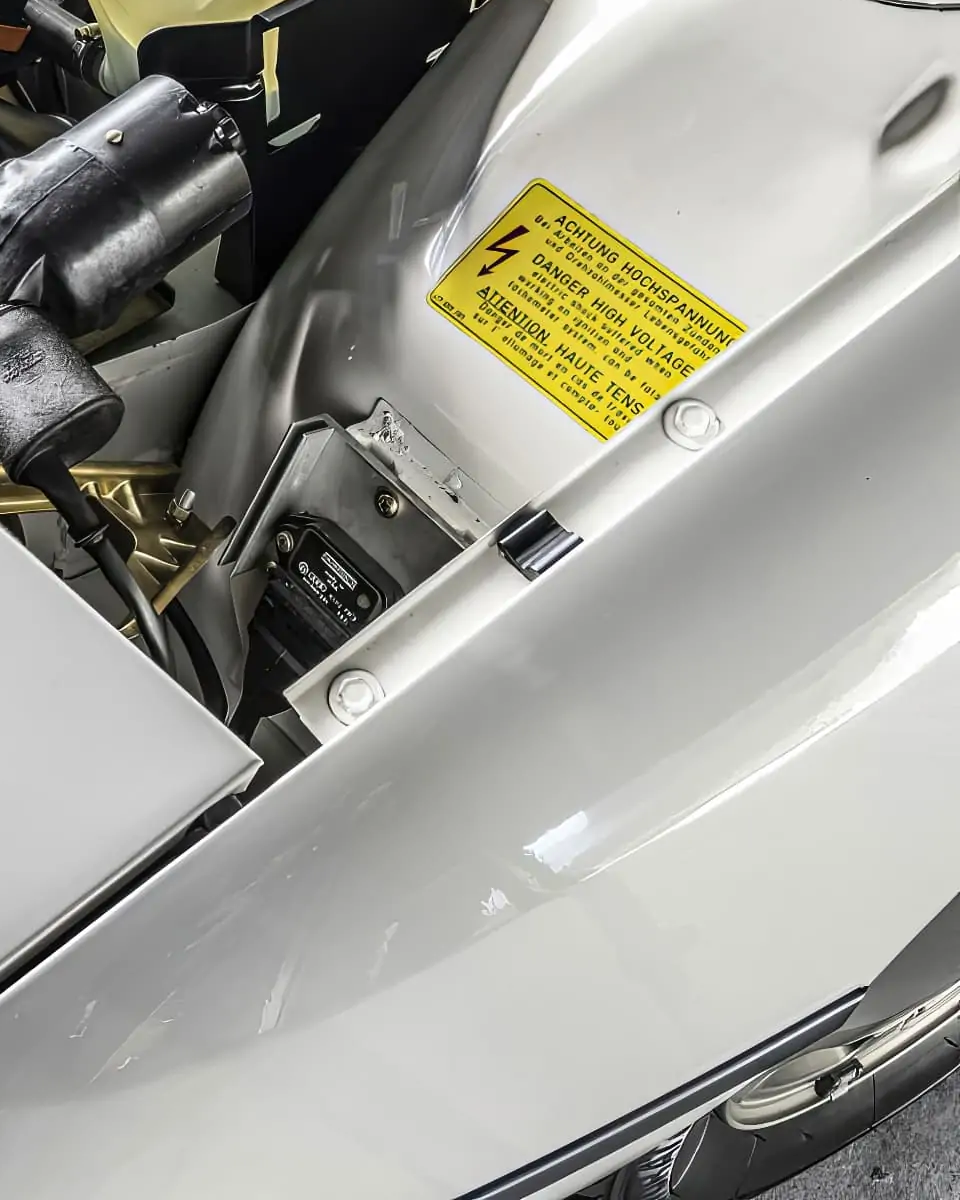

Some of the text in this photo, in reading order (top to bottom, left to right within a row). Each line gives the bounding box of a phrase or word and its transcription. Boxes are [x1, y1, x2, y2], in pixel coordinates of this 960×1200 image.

[543, 237, 565, 254] und
[551, 228, 594, 262] Arbeiten
[595, 261, 609, 274] an
[610, 272, 629, 287] der
[629, 287, 680, 325] gesamten
[552, 214, 620, 264] ACHTUNG
[471, 311, 489, 327] sur
[500, 334, 544, 370] allumage
[546, 370, 559, 381] et
[477, 300, 513, 329] Danger
[513, 329, 528, 343] de
[528, 341, 553, 362] mort
[554, 361, 568, 375] en
[590, 389, 604, 403] de
[506, 279, 560, 323] tachometer
[601, 353, 621, 370] can
[622, 368, 637, 383] be
[516, 273, 555, 306] working
[571, 315, 610, 346] ignition
[611, 345, 633, 364] and
[530, 252, 696, 378] DANGER HIGH VOLTAGE
[530, 270, 672, 379] electric shock suffered when
[553, 342, 605, 384] HAUTE
[604, 379, 645, 416] TENS
